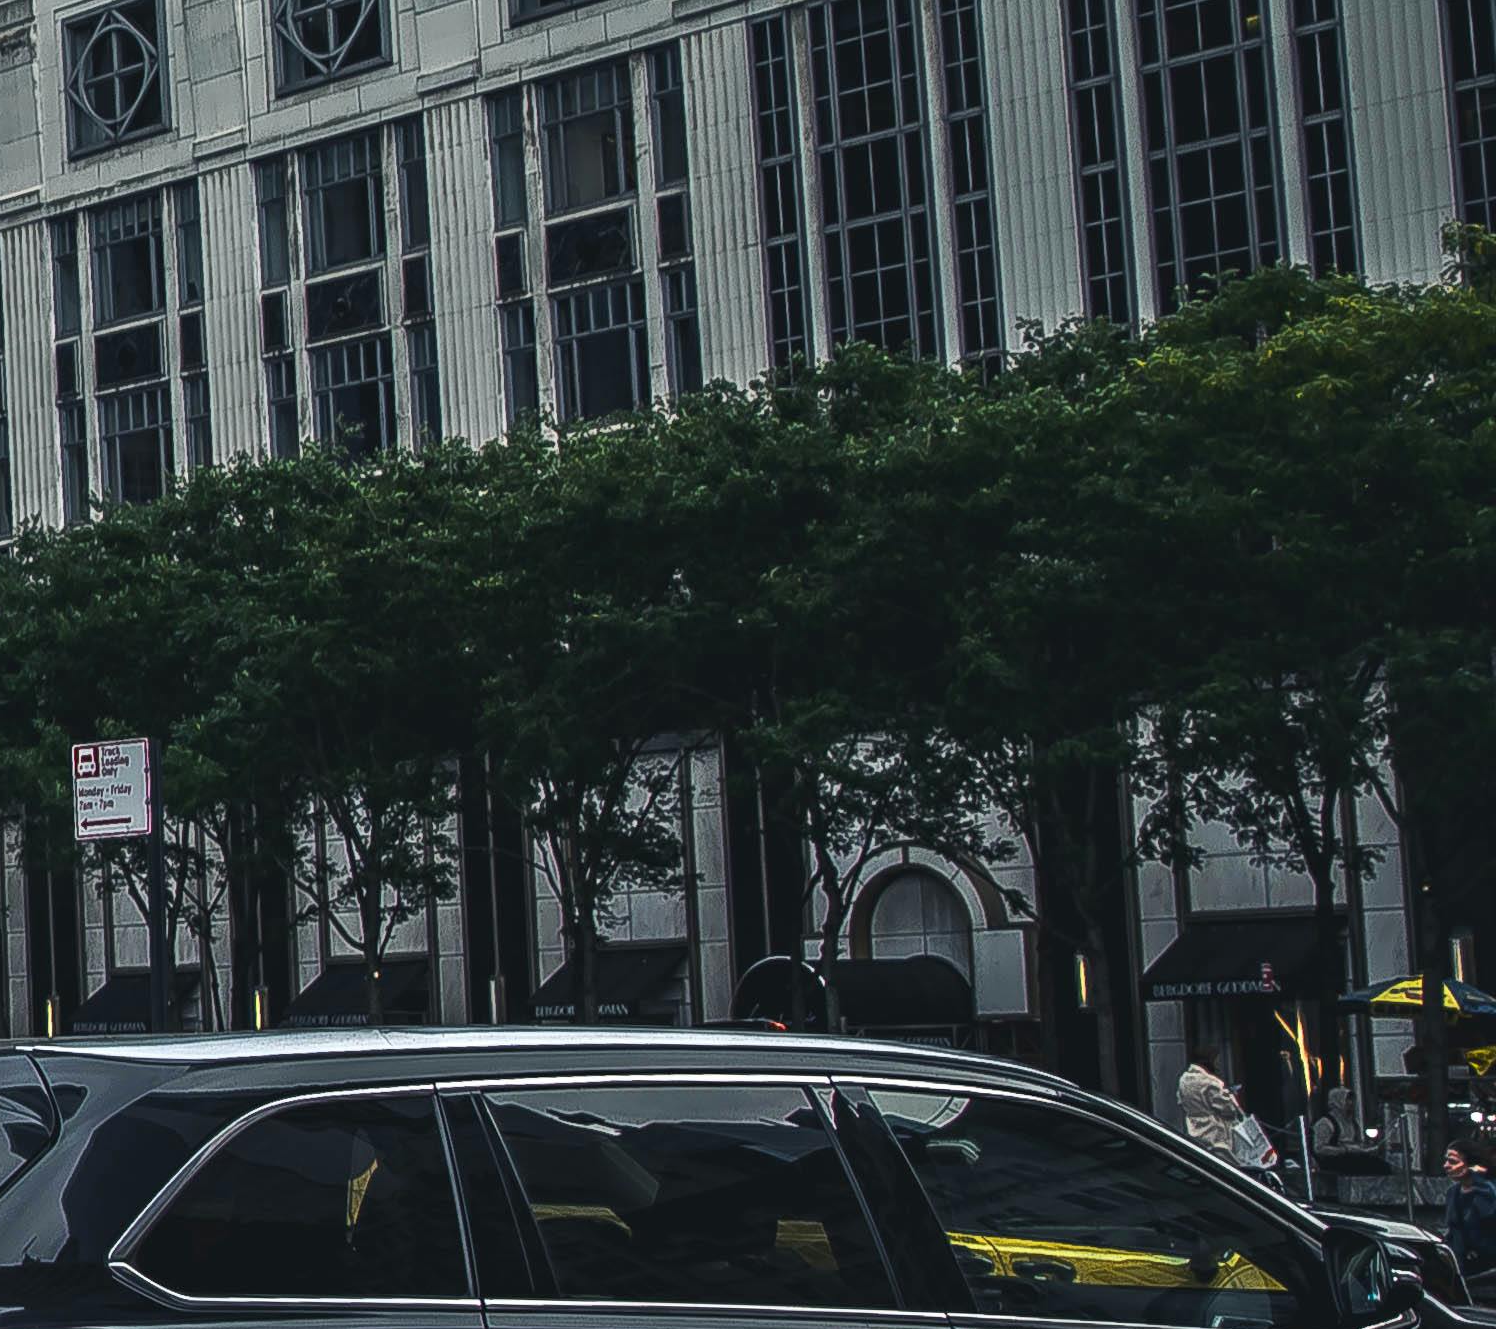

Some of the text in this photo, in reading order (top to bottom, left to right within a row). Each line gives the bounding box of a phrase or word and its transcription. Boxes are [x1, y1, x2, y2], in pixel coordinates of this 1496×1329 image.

[102, 746, 120, 757] Truck
[102, 756, 130, 767] Loading
[79, 786, 104, 797] Monday
[111, 784, 132, 795] Friday
